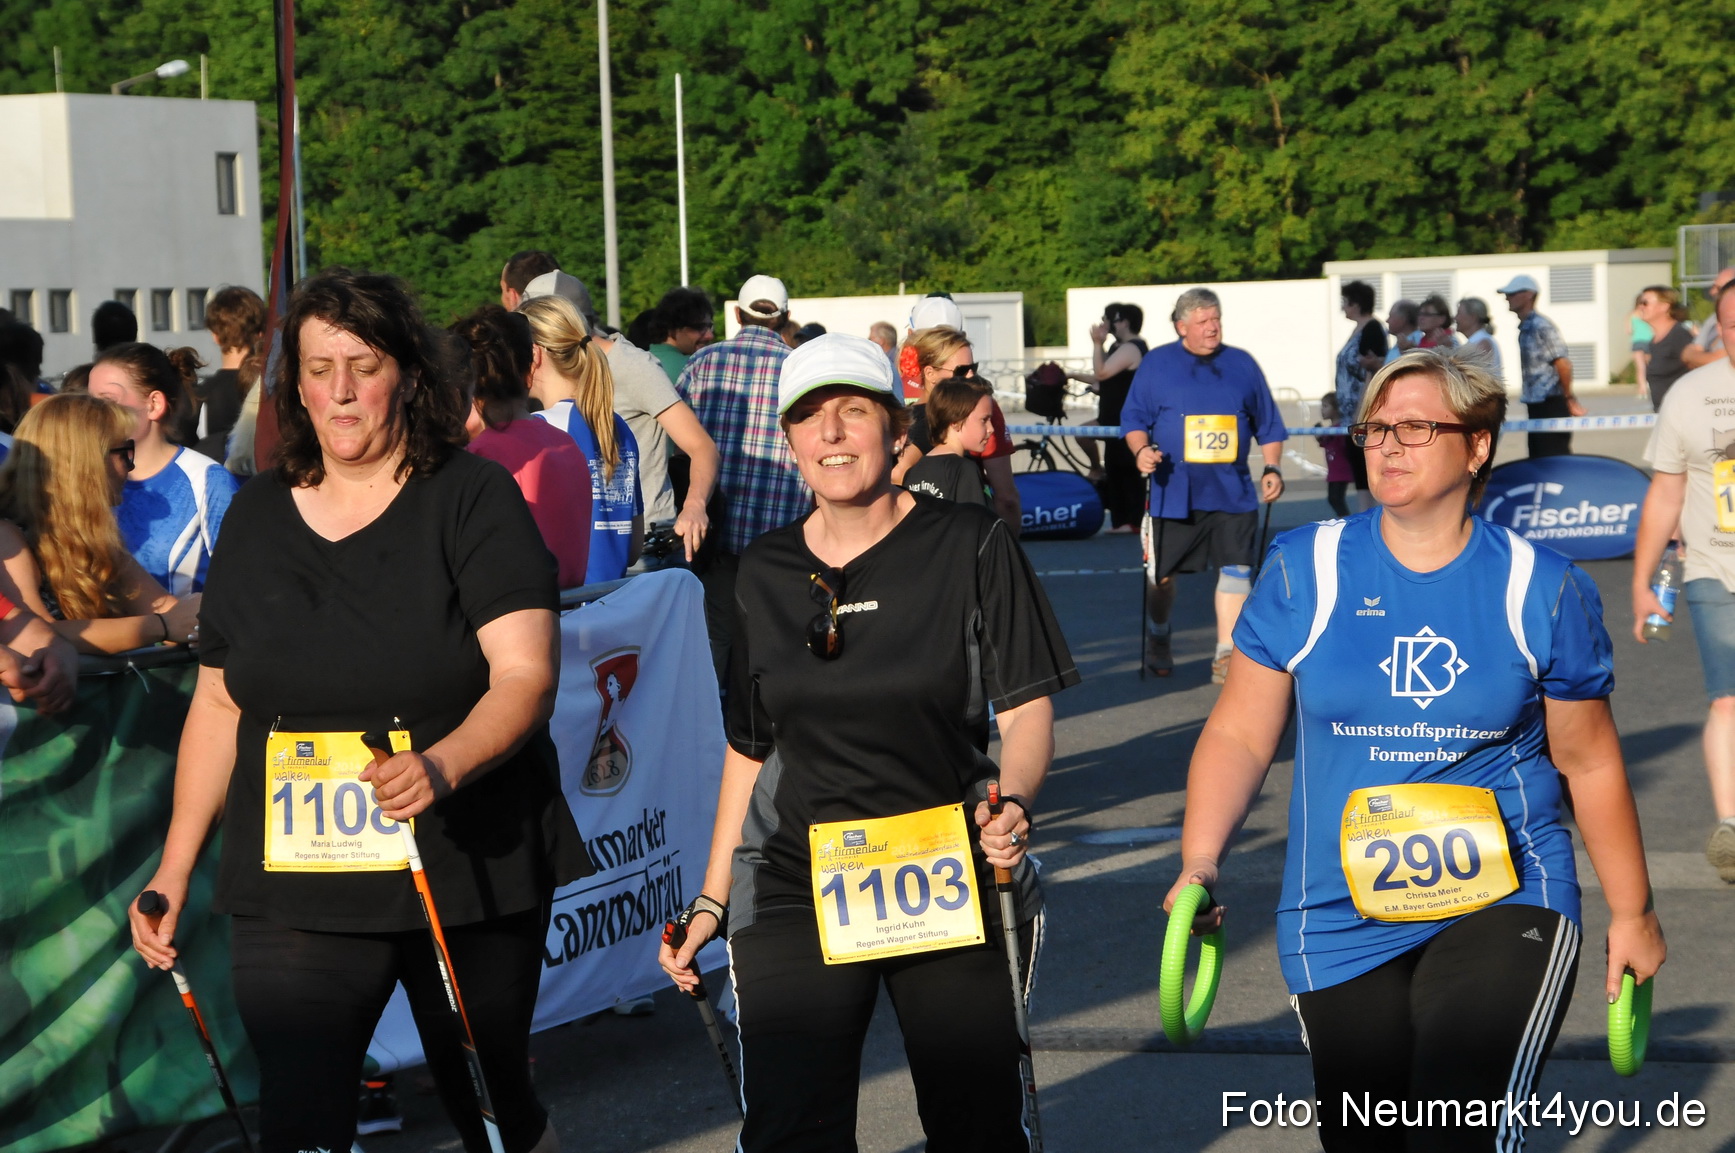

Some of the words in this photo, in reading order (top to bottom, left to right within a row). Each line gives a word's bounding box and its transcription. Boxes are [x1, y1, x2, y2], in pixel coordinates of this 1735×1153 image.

[1195, 432, 1229, 450] 129
[1021, 503, 1082, 527] cher
[1511, 500, 1637, 529] Fischer
[1524, 524, 1627, 540] AUTOMOBILE
[1356, 608, 1386, 617] erima
[1331, 722, 1509, 742] Kunststoffspritzerei
[286, 756, 333, 767] firmenlauf
[274, 771, 311, 782] walken
[587, 760, 620, 787] 1628
[1359, 806, 1416, 824] firmenlauf
[1347, 828, 1392, 842] walken
[310, 840, 331, 848] Maria
[331, 840, 363, 849] Ludwig
[834, 841, 889, 857] firmenlauf
[294, 852, 320, 861] Regens
[321, 852, 349, 861] Wagner
[350, 851, 380, 860] Stiftung
[1364, 828, 1482, 892] 290
[821, 861, 865, 874] walken
[821, 857, 970, 927] 1103
[1405, 891, 1437, 900] Christa
[1438, 886, 1463, 896] Meier
[1384, 905, 1402, 913] E.M.
[1403, 902, 1425, 913] Bayer
[1427, 899, 1452, 909] GmbH
[1453, 897, 1460, 905] &
[1461, 895, 1476, 903] Co.
[1477, 891, 1490, 900] KG
[543, 854, 684, 968] Lammsbräu
[876, 922, 902, 934] Ingrid
[902, 920, 926, 931] Kuhn
[856, 938, 886, 949] Regens
[886, 933, 917, 946] Wagner
[917, 928, 949, 940] Stiftung
